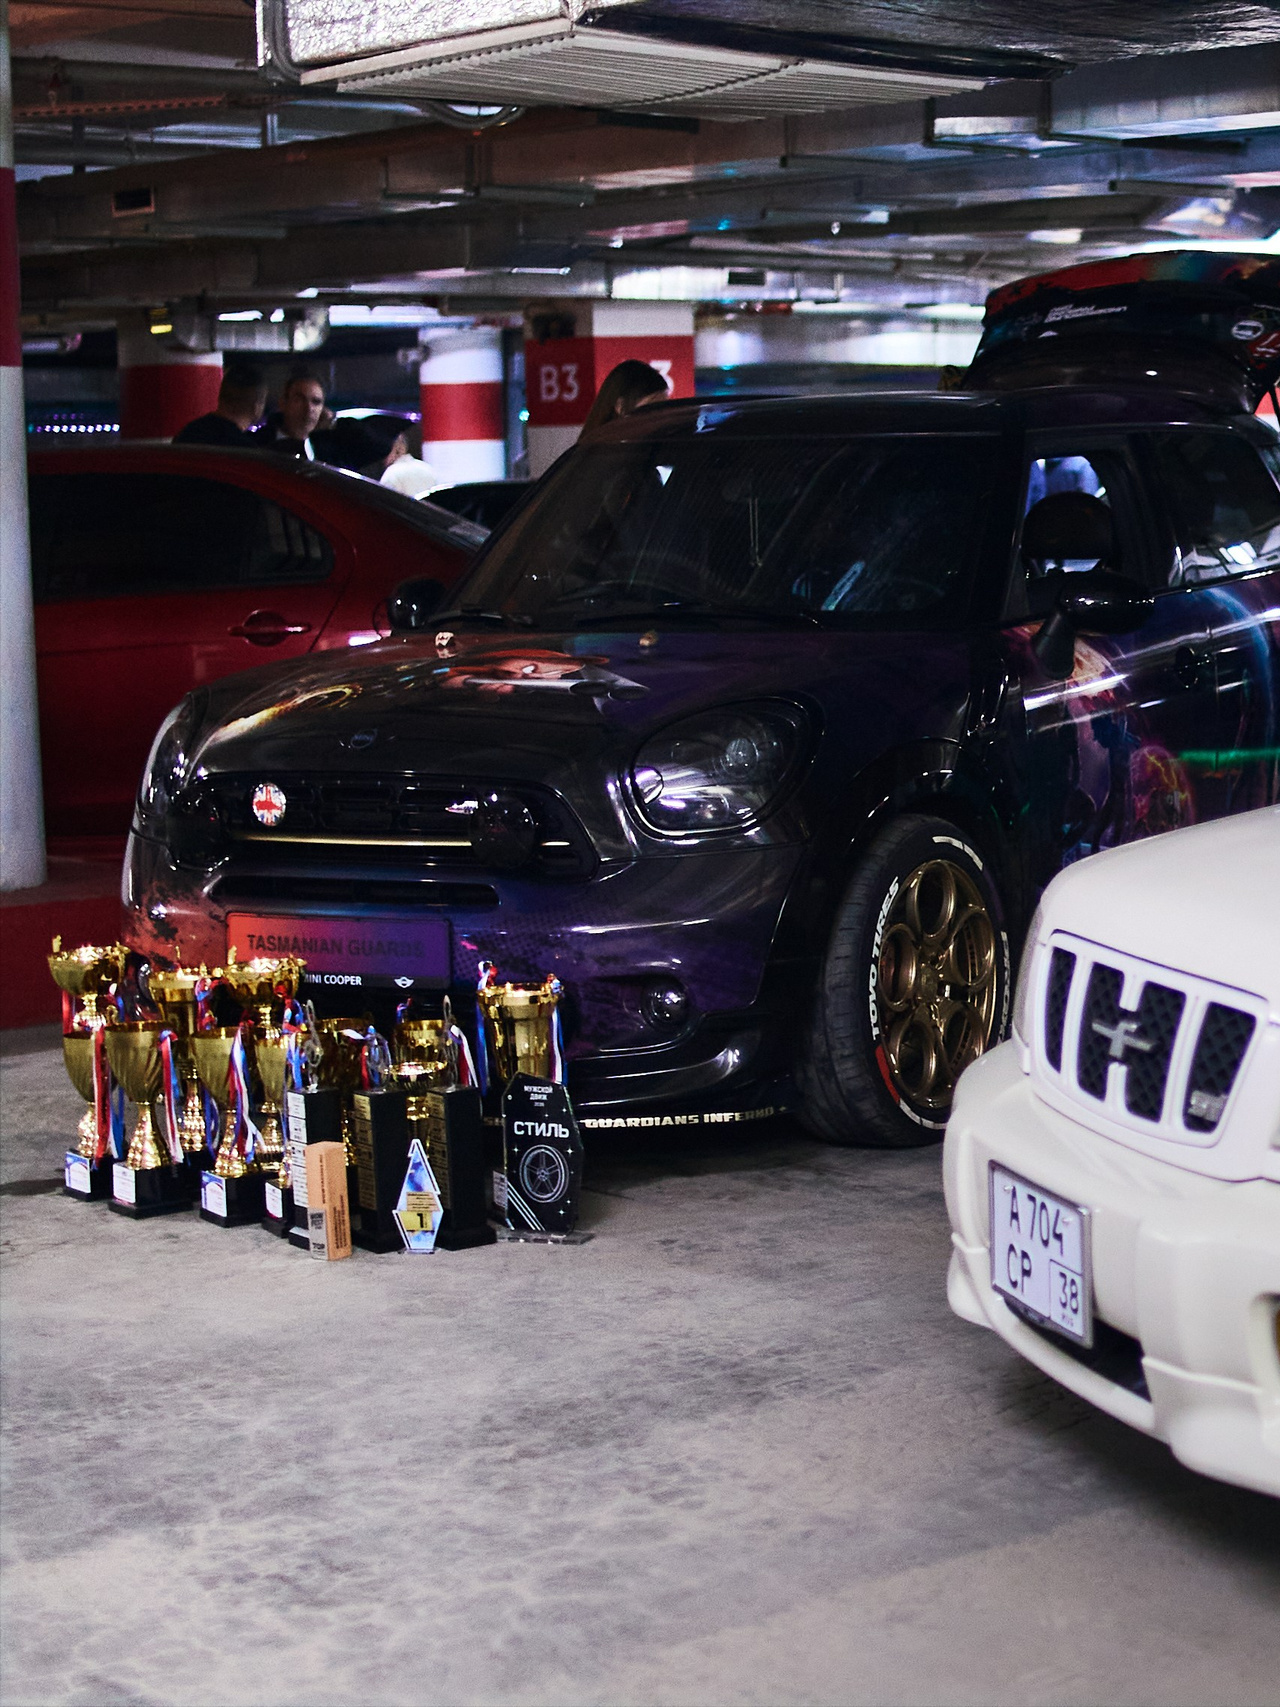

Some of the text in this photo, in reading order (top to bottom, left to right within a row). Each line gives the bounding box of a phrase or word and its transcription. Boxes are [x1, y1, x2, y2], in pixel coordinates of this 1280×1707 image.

[539, 364, 579, 402] B3
[649, 360, 675, 396] 3
[247, 934, 344, 955] TASMANIAN
[868, 876, 900, 1041] TOYO TIRES
[324, 974, 362, 986] COOPER
[513, 1121, 570, 1139] СТИЛЬ
[584, 1114, 699, 1129] GUARDIANS
[416, 1212, 424, 1229] 1
[1027, 1193, 1064, 1257] 704
[1059, 1271, 1079, 1315] 38
